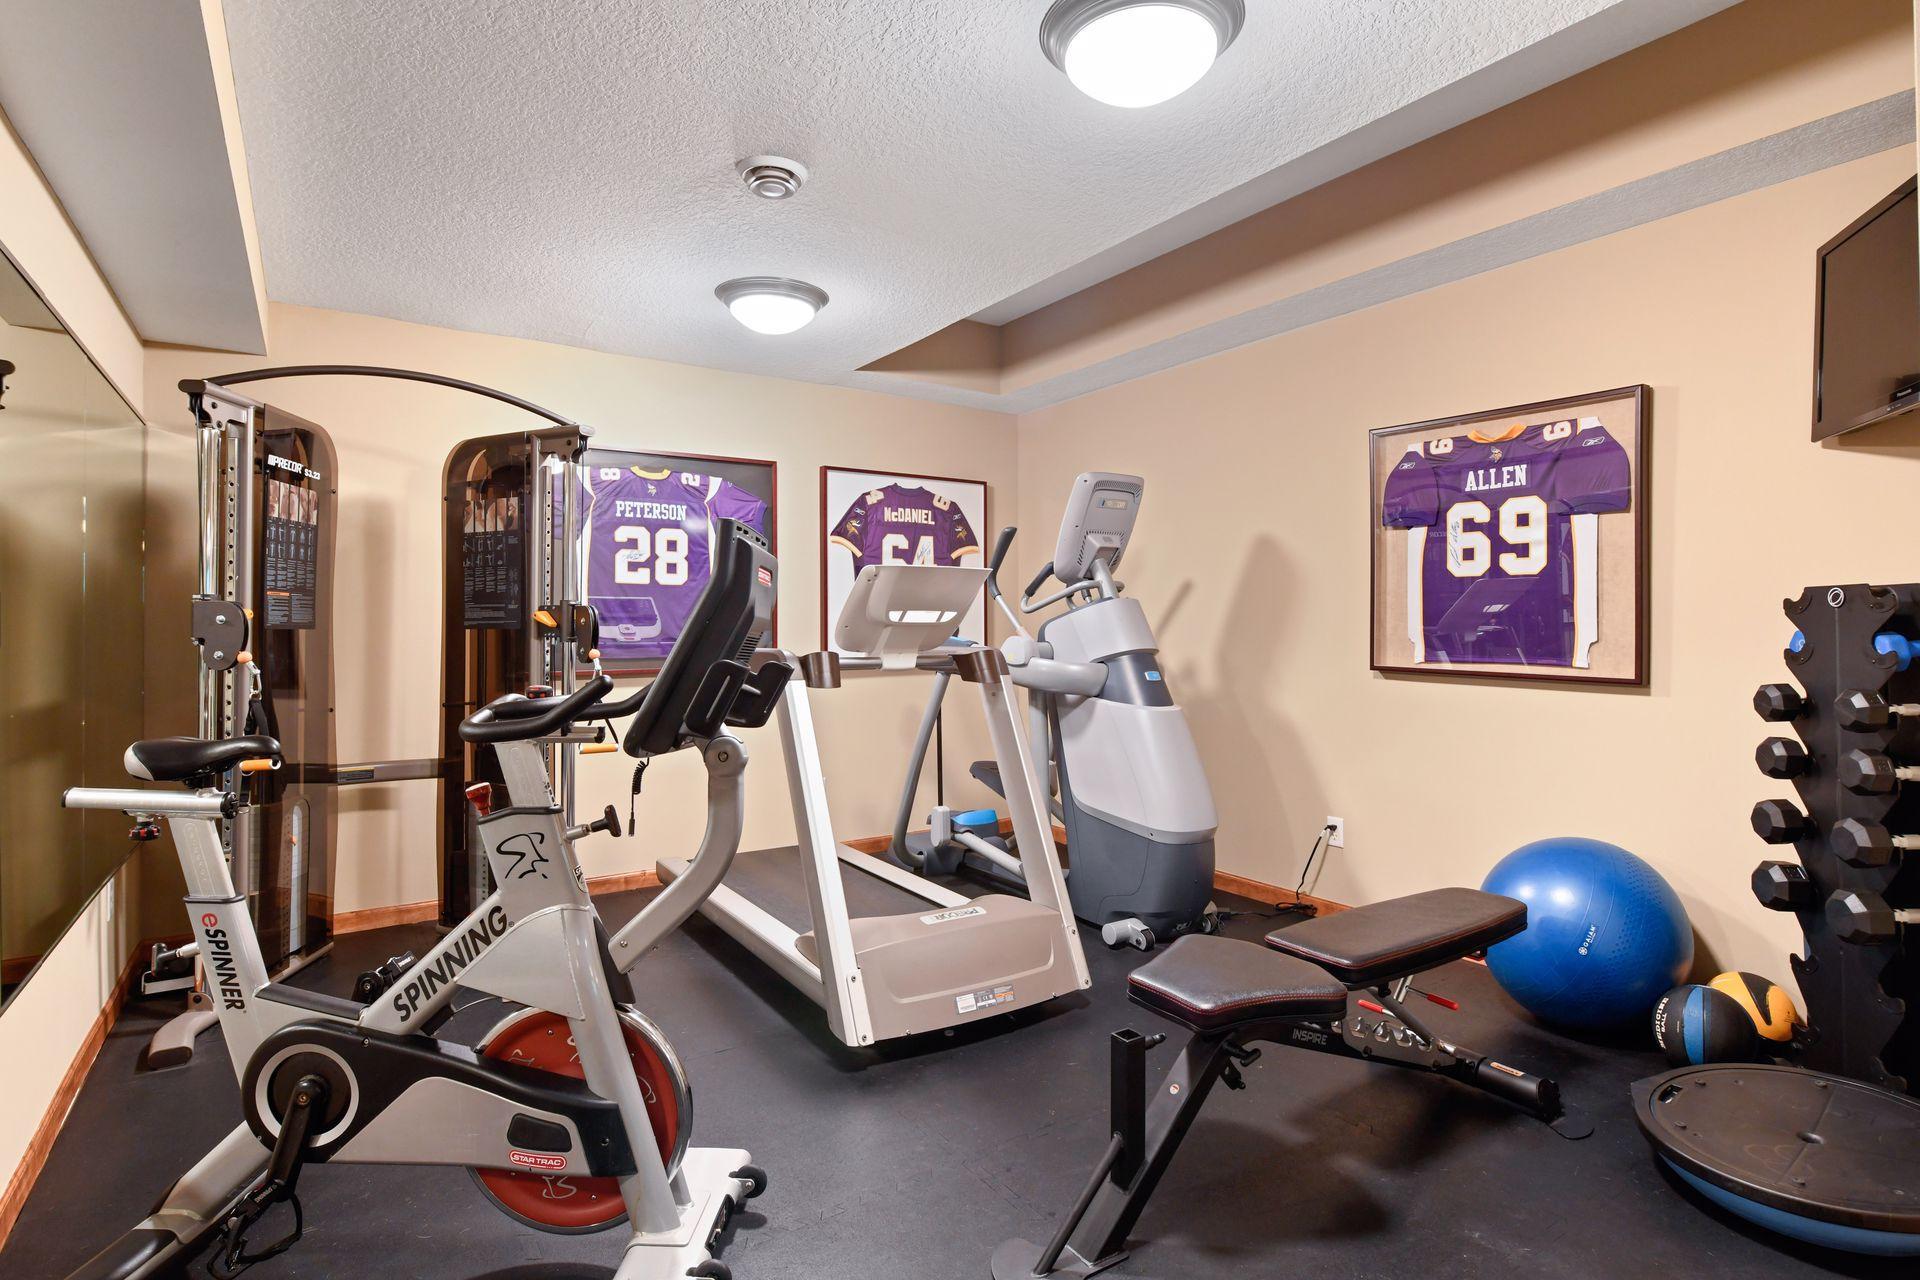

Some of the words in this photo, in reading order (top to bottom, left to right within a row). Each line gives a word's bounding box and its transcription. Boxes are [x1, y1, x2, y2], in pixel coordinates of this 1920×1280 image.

[271, 455, 303, 474] PRECOR
[1464, 464, 1527, 492] ALLEN
[615, 500, 687, 521] PETERSON
[883, 507, 935, 525] McDANIEL
[1446, 494, 1548, 577] 69
[614, 525, 689, 586] 28
[392, 905, 508, 1023] SPINNING
[1292, 1028, 1329, 1046] INSPIRE
[512, 1154, 536, 1164] STAR
